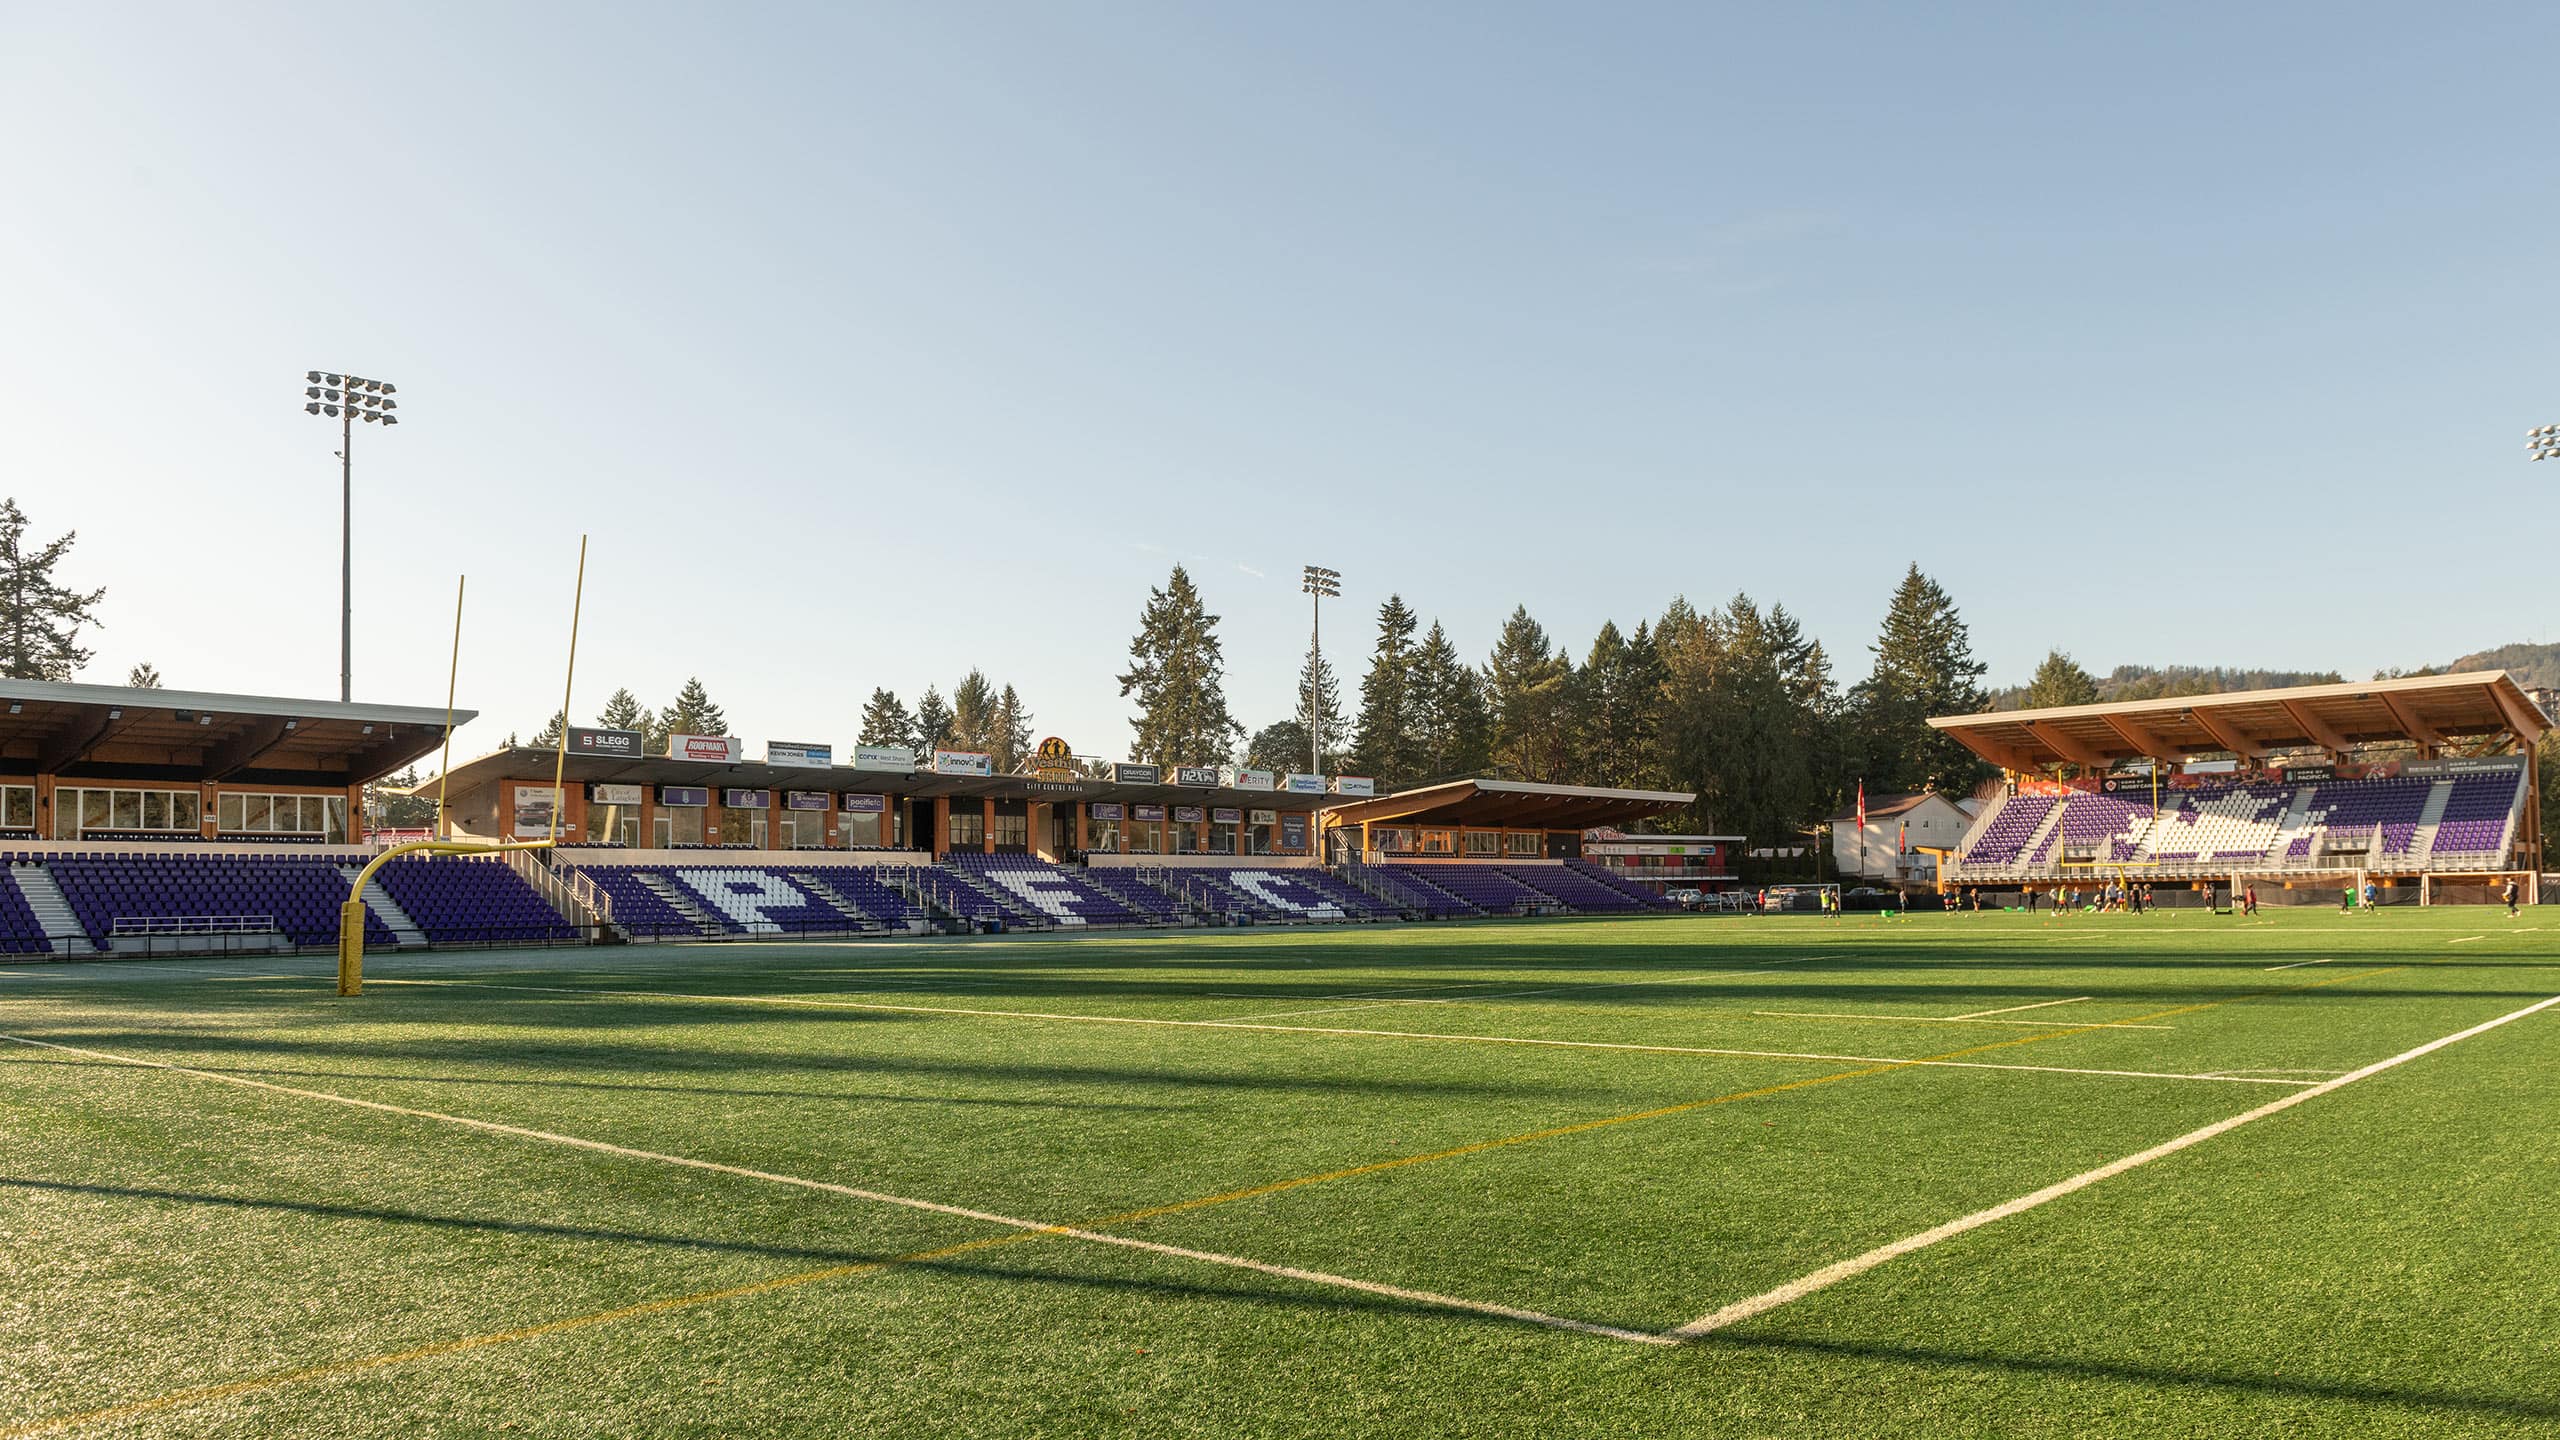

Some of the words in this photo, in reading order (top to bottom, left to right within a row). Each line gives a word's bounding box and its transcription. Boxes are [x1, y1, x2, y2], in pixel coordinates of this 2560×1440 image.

[595, 735, 630, 746] SLEGG
[950, 755, 975, 767] innov8
[1024, 754, 1090, 777] Westhills
[1039, 769, 1077, 784] STADIUM
[676, 870, 807, 933] P
[985, 871, 1087, 925] F
